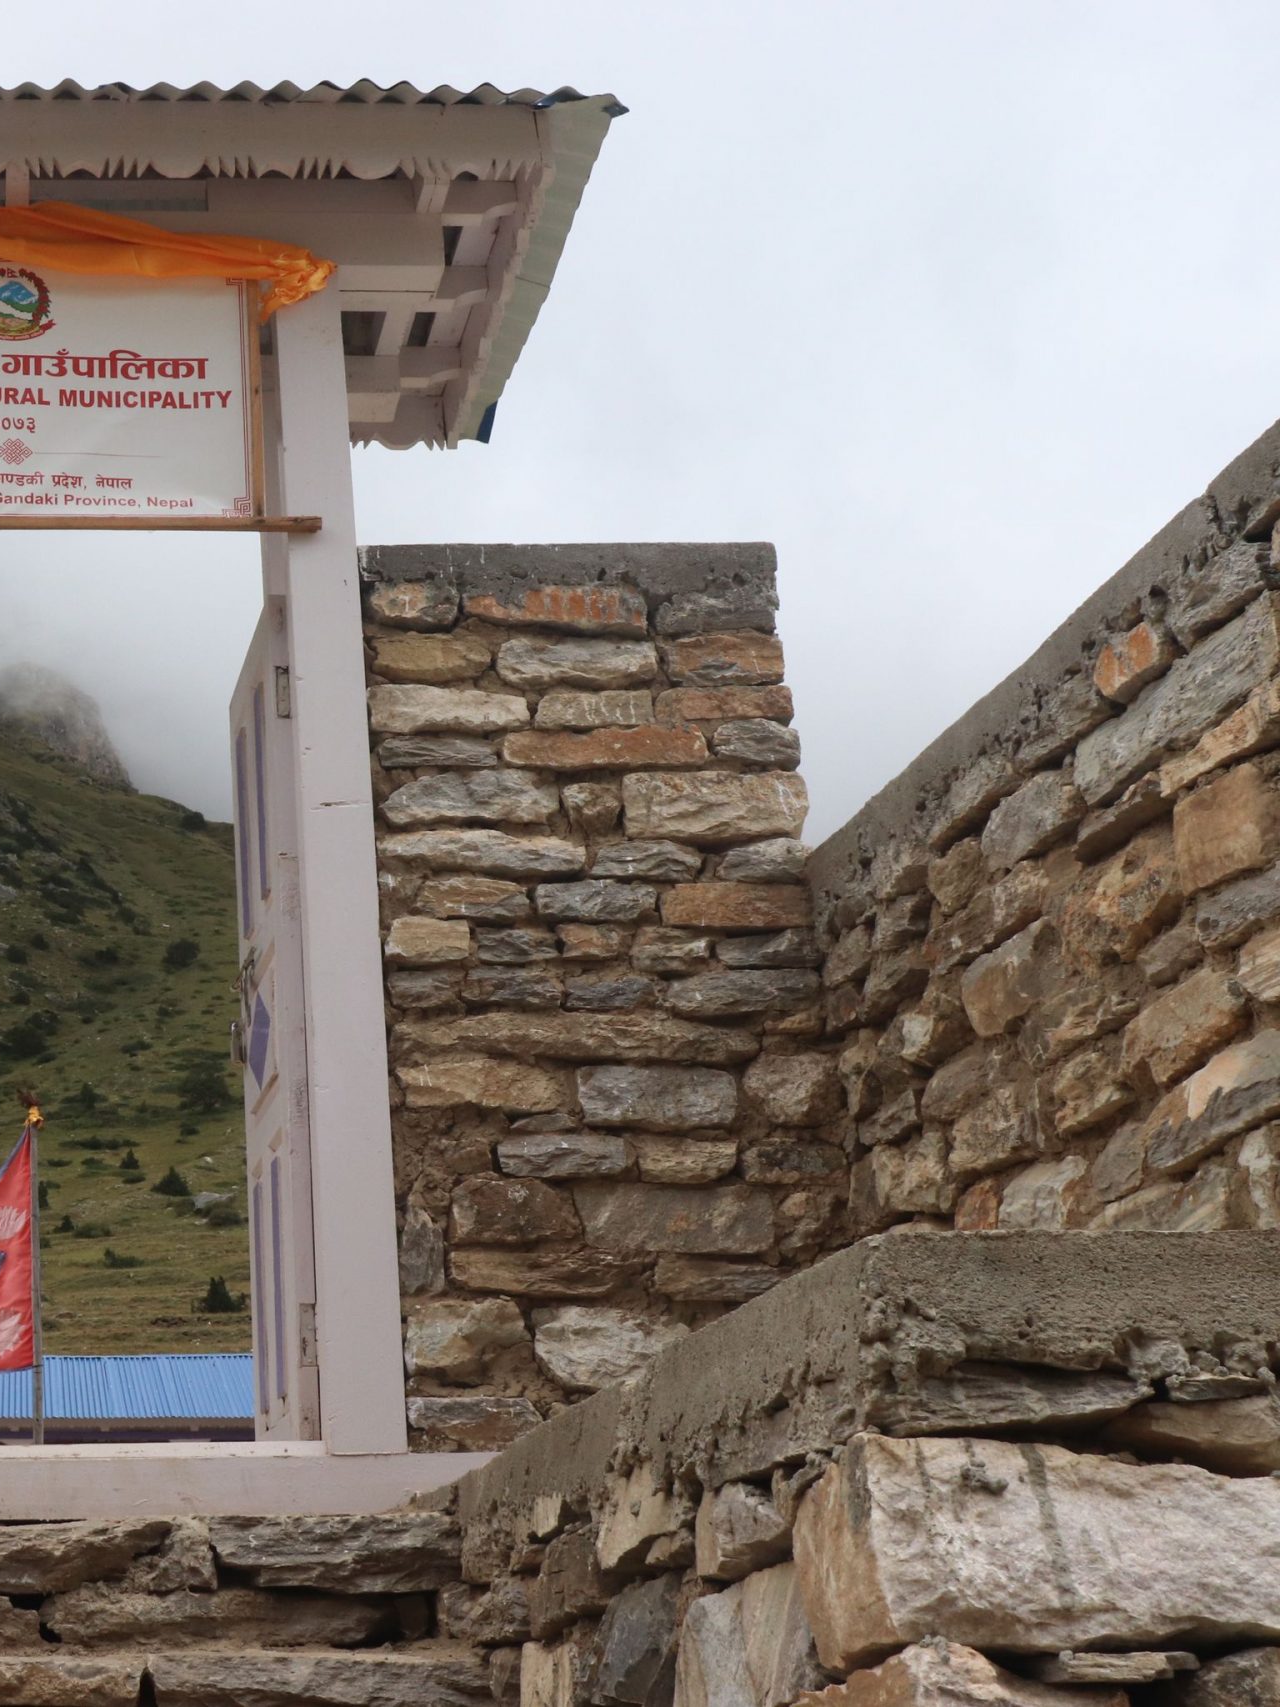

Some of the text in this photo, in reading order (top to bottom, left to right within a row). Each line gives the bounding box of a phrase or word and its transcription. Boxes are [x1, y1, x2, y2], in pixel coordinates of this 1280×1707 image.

[1, 348, 209, 382] गाउँपालिका
[57, 388, 233, 411] MUNICIPALITY
[51, 473, 87, 490] प्रदेश,
[95, 474, 133, 489] नेपाल
[63, 494, 142, 509] Province,
[146, 496, 194, 509] Nepal
